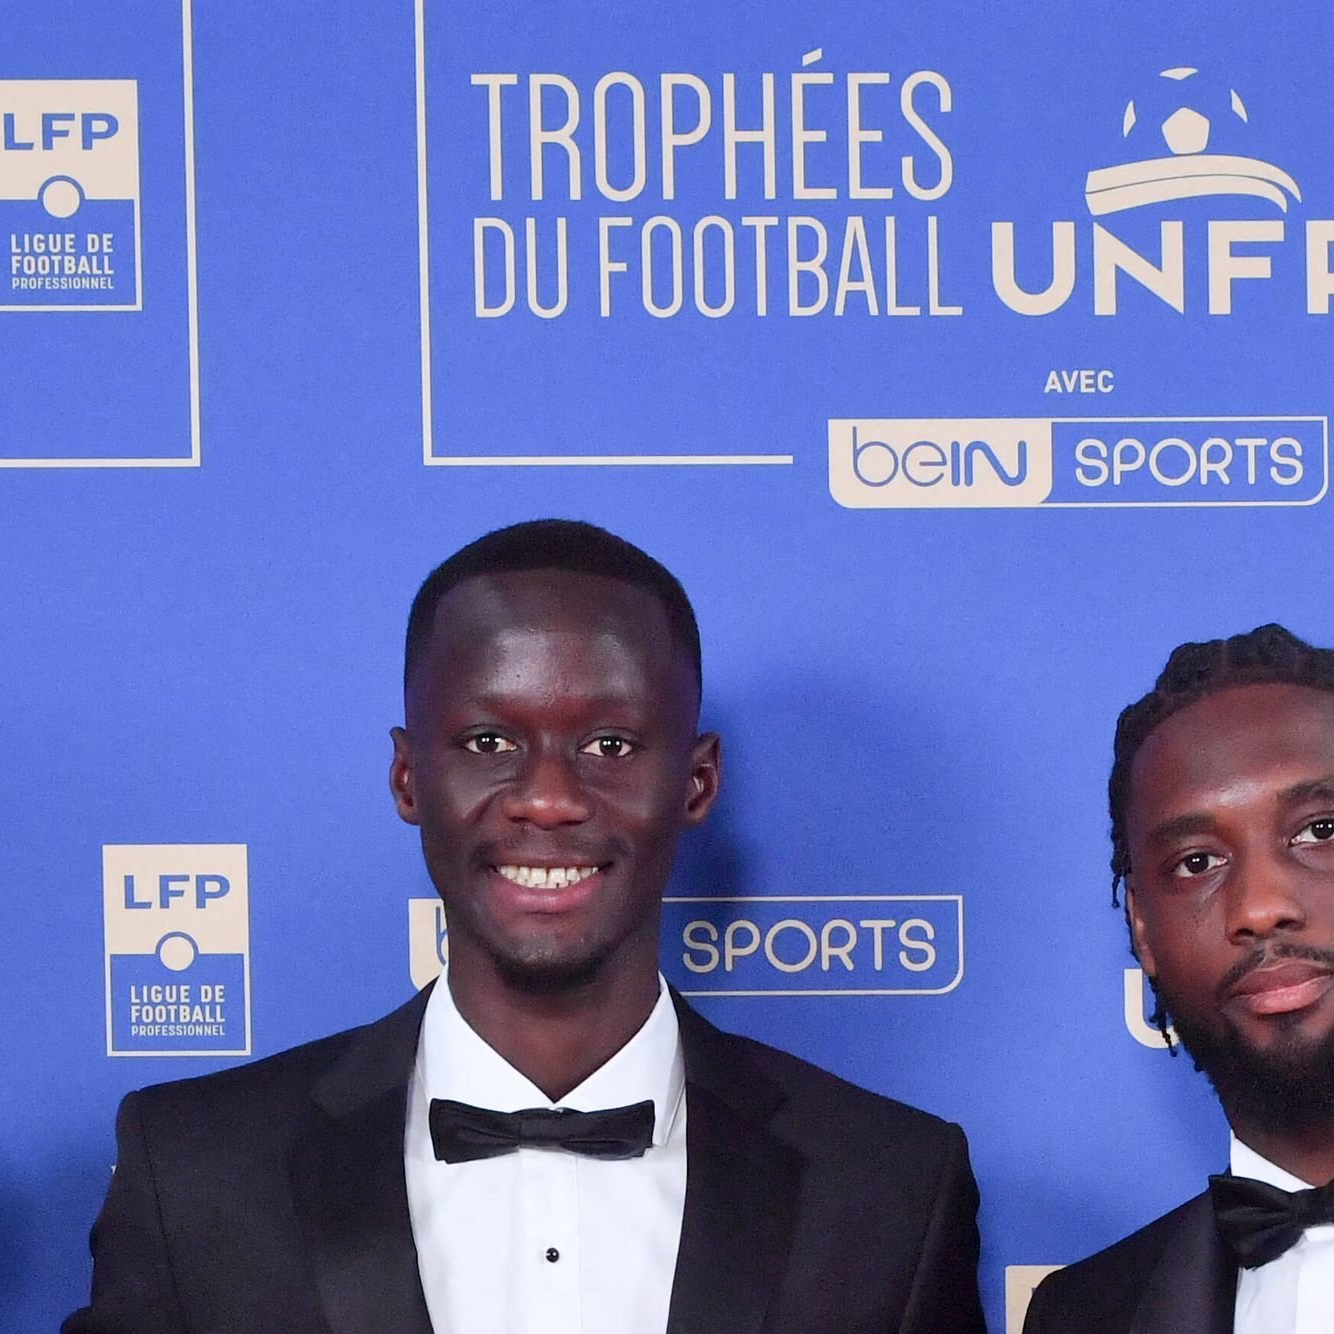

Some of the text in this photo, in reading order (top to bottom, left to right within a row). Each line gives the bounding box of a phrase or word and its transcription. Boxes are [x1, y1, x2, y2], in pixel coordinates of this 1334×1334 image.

[4, 113, 118, 150] LFP
[471, 48, 952, 201] TROPHÉES
[11, 234, 113, 253] LIGUE DE
[12, 256, 113, 274] FOOTBALL
[474, 216, 962, 318] DU FOOTBALL
[12, 277, 113, 289] PROFESSIONNEL
[1045, 370, 1113, 392] AVEC
[853, 426, 1303, 487] beIN SPORTS
[124, 875, 230, 909] LFP
[684, 919, 936, 972] SPORTS
[131, 985, 224, 1003] LIGUE DE
[132, 1005, 225, 1022] FOOTBALL
[132, 1025, 224, 1036] PROFESSIONNEL
